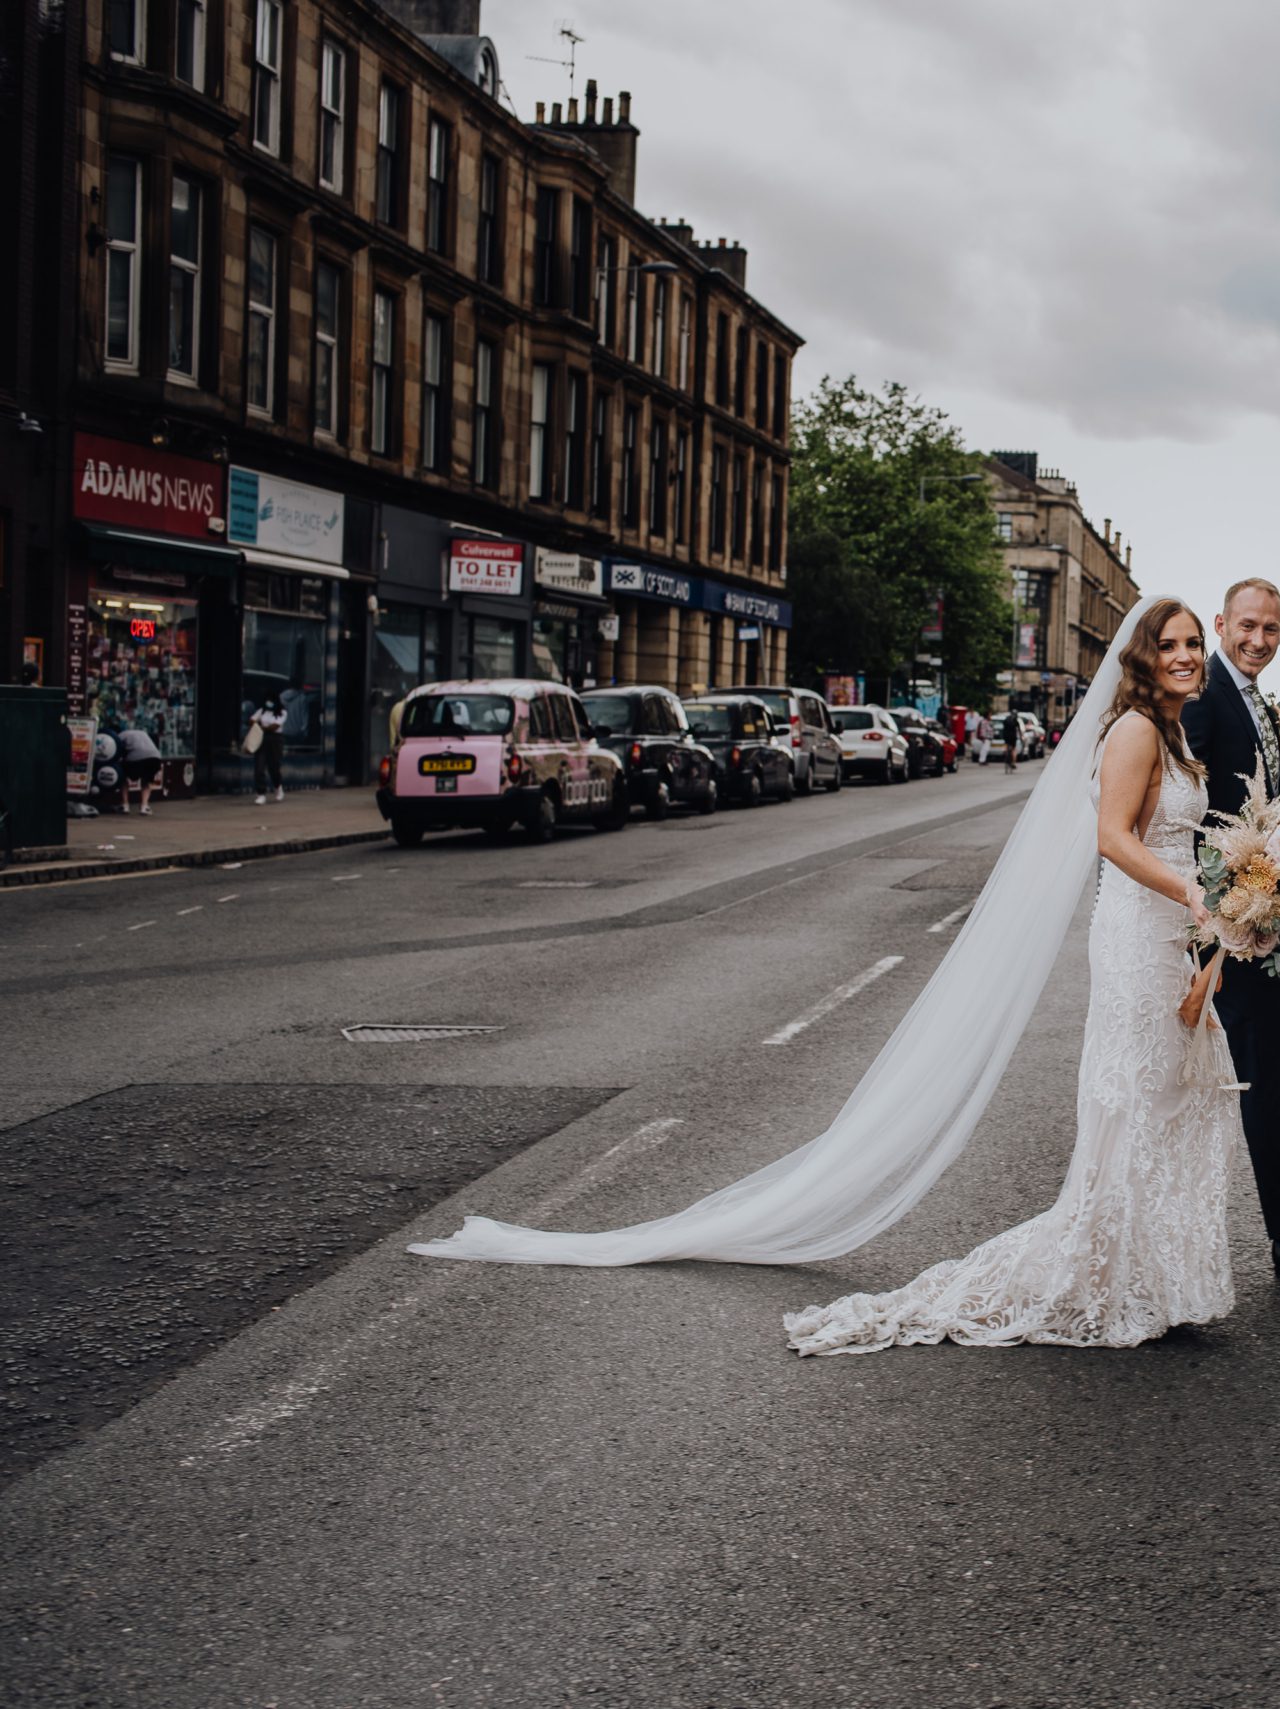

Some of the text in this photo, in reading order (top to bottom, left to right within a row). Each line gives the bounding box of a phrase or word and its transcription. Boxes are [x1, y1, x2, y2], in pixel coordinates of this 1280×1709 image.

[81, 458, 215, 516] ADAM'S NEWS
[460, 543, 514, 558] Culverwell
[455, 560, 518, 578] TO LET
[646, 572, 656, 593] OF
[657, 574, 691, 602] SCOTLAND
[732, 592, 747, 613] BANK
[754, 599, 780, 621] SCOTLAND
[130, 618, 156, 639] OPEN
